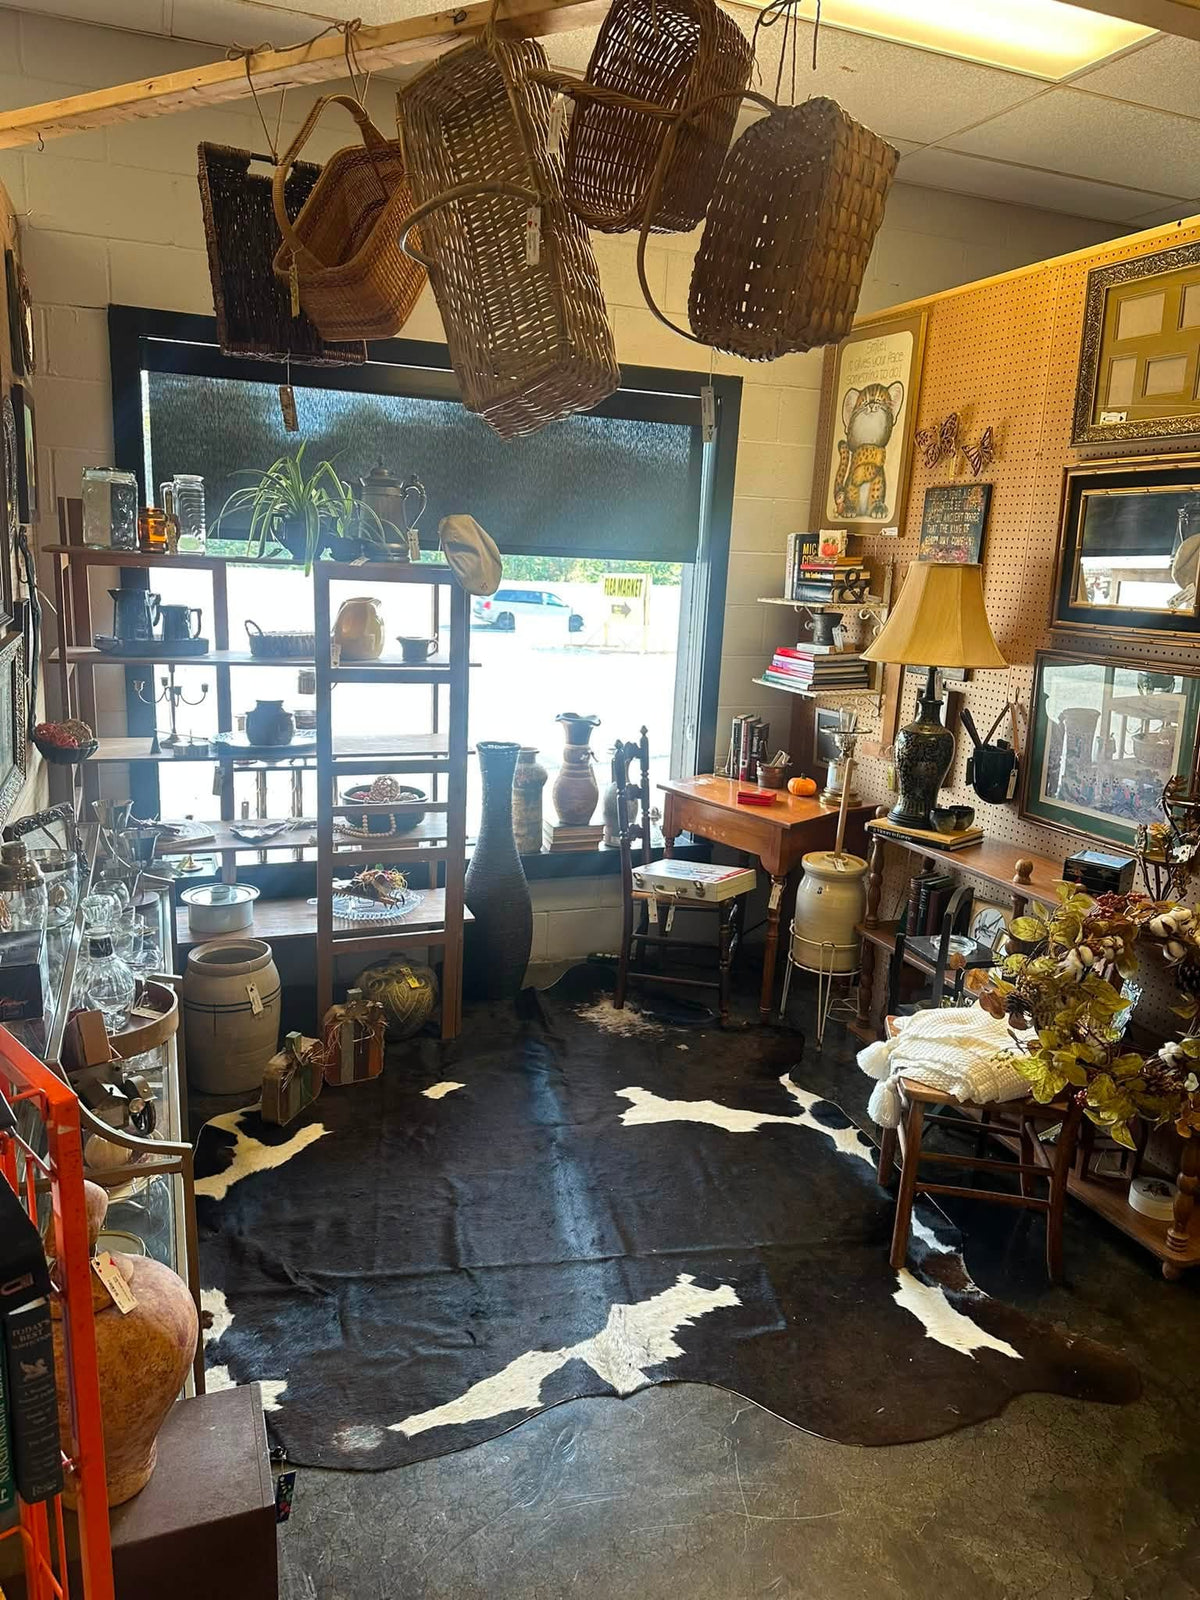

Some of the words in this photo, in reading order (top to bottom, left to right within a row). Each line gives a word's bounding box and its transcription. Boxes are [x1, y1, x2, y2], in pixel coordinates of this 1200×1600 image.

[940, 523, 949, 534] THE
[950, 523, 963, 534] KING
[963, 523, 971, 533] OF
[604, 577, 616, 596] FLEA
[617, 577, 643, 598] MARKET
[20, 1329, 44, 1343] BEST
